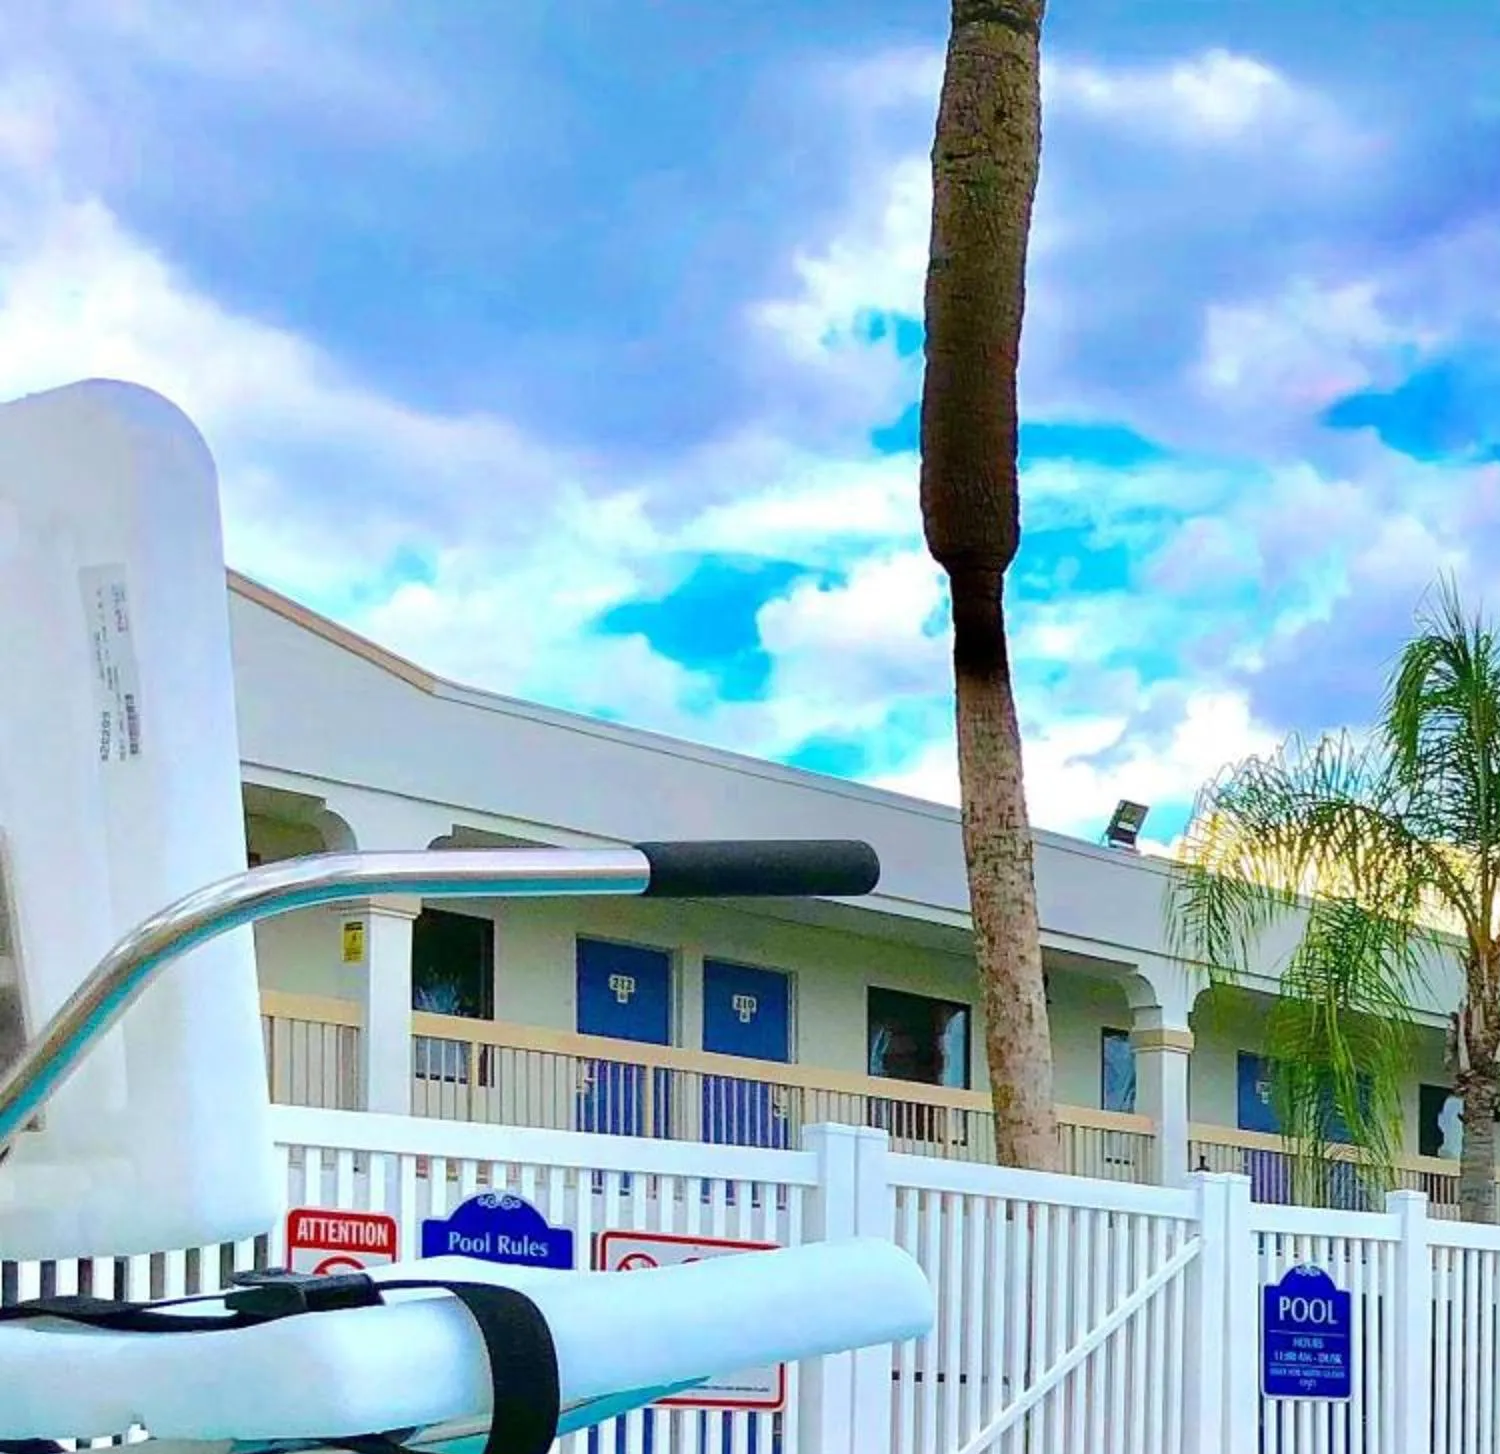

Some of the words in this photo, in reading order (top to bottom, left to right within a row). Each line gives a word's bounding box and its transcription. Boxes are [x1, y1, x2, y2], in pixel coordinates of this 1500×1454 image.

[297, 1217, 388, 1246] ATTENTION
[448, 1232, 490, 1254] Pool
[497, 1235, 549, 1257] Rules
[1278, 1296, 1338, 1325] POOL
